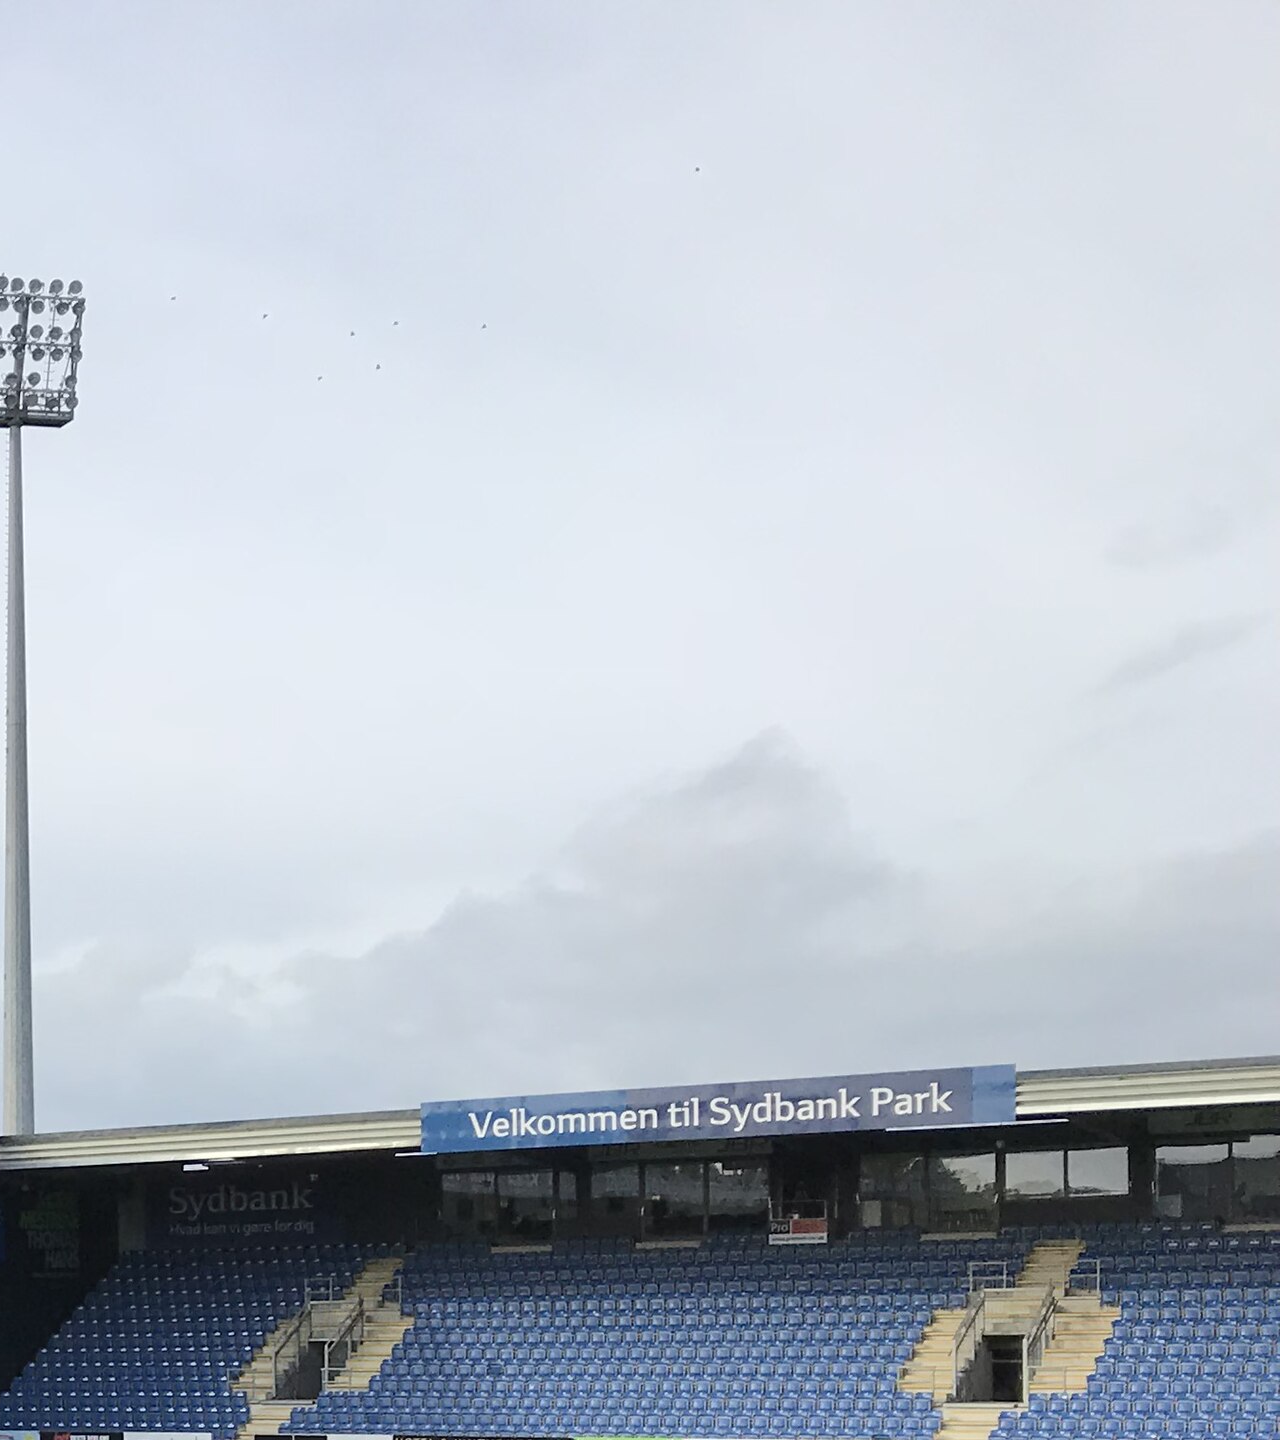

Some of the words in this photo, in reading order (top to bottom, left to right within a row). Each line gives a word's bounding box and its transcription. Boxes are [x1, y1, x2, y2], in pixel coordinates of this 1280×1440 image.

[468, 1107, 659, 1139] Velkommen
[667, 1097, 700, 1128] til
[710, 1088, 862, 1133] Sydbank
[870, 1082, 954, 1117] Park
[168, 1182, 315, 1221] Sydbank
